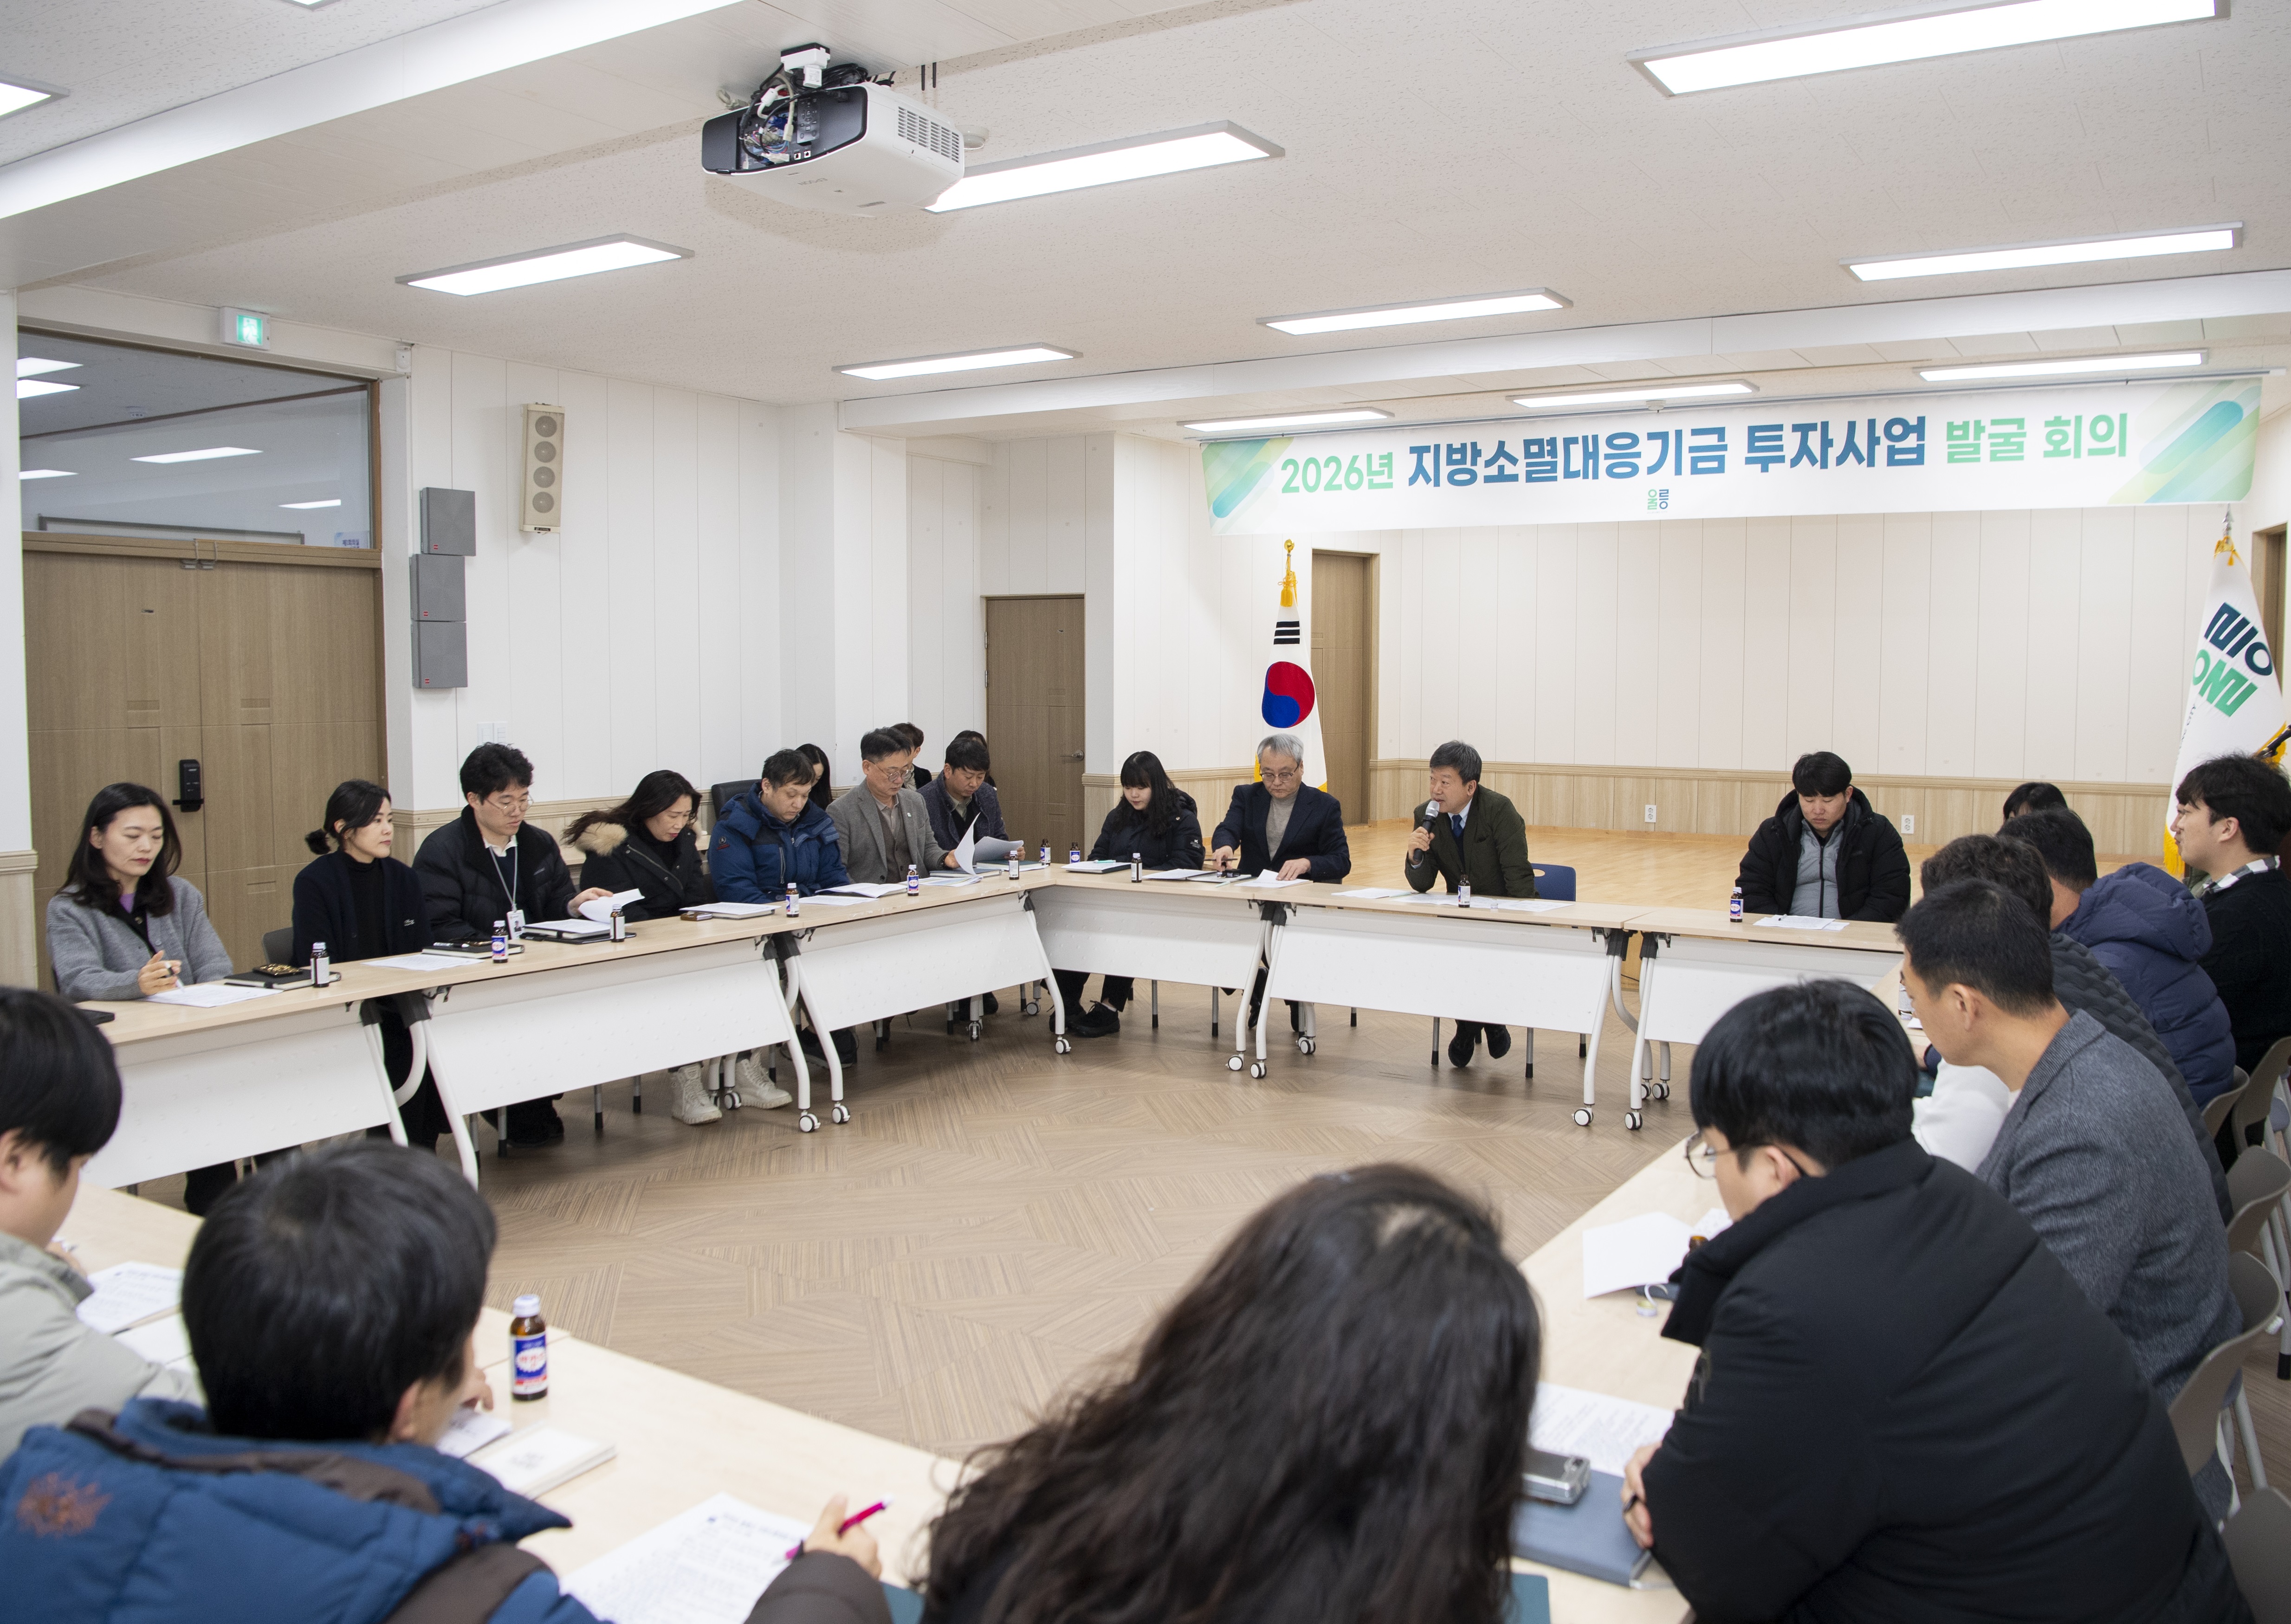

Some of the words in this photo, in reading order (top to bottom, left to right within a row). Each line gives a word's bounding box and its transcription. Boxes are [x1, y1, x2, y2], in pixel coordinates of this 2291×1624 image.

[1281, 451, 1393, 493] 2026년
[1408, 426, 1728, 487] 지방소멸대응기금
[1745, 416, 1926, 472] 투자사업
[1947, 418, 2026, 464] 발굴
[2043, 412, 2128, 458] 회의
